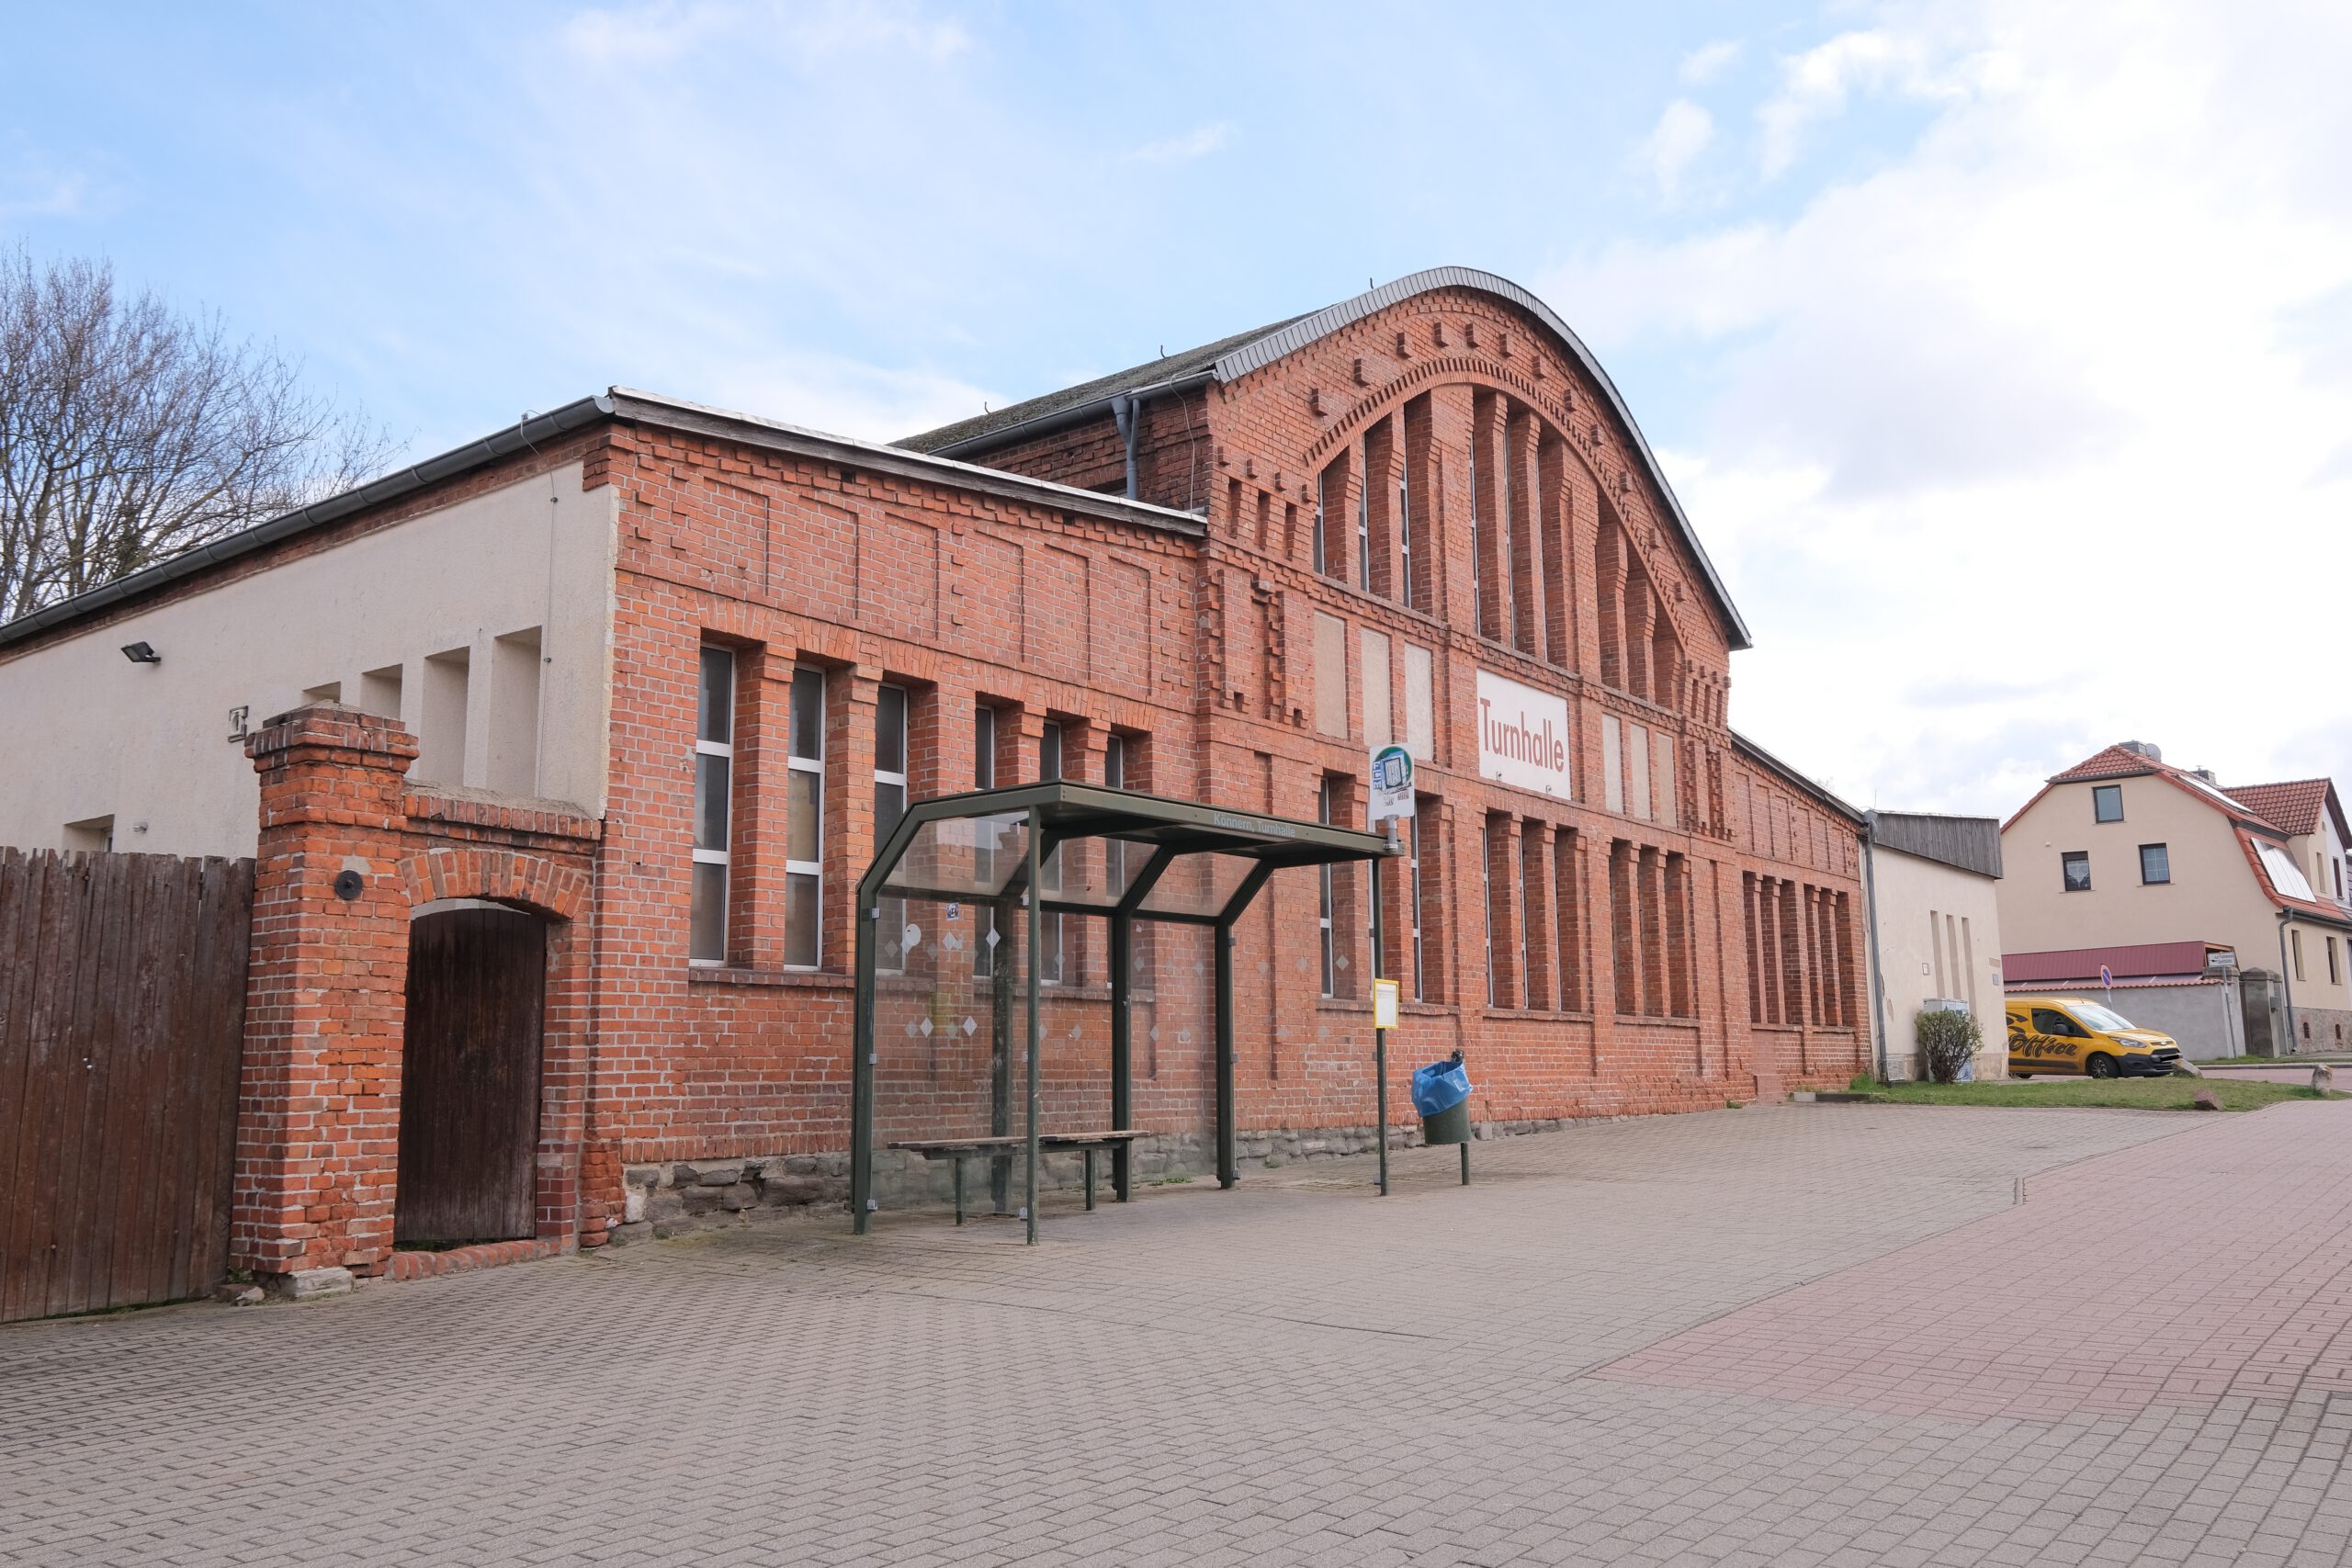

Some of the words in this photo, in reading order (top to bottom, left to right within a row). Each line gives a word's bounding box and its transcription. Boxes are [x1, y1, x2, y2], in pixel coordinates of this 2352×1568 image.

[1480, 697, 1564, 773] Turnhalle
[1214, 812, 1255, 832] Könnern,
[1257, 820, 1295, 837] Turnhalle
